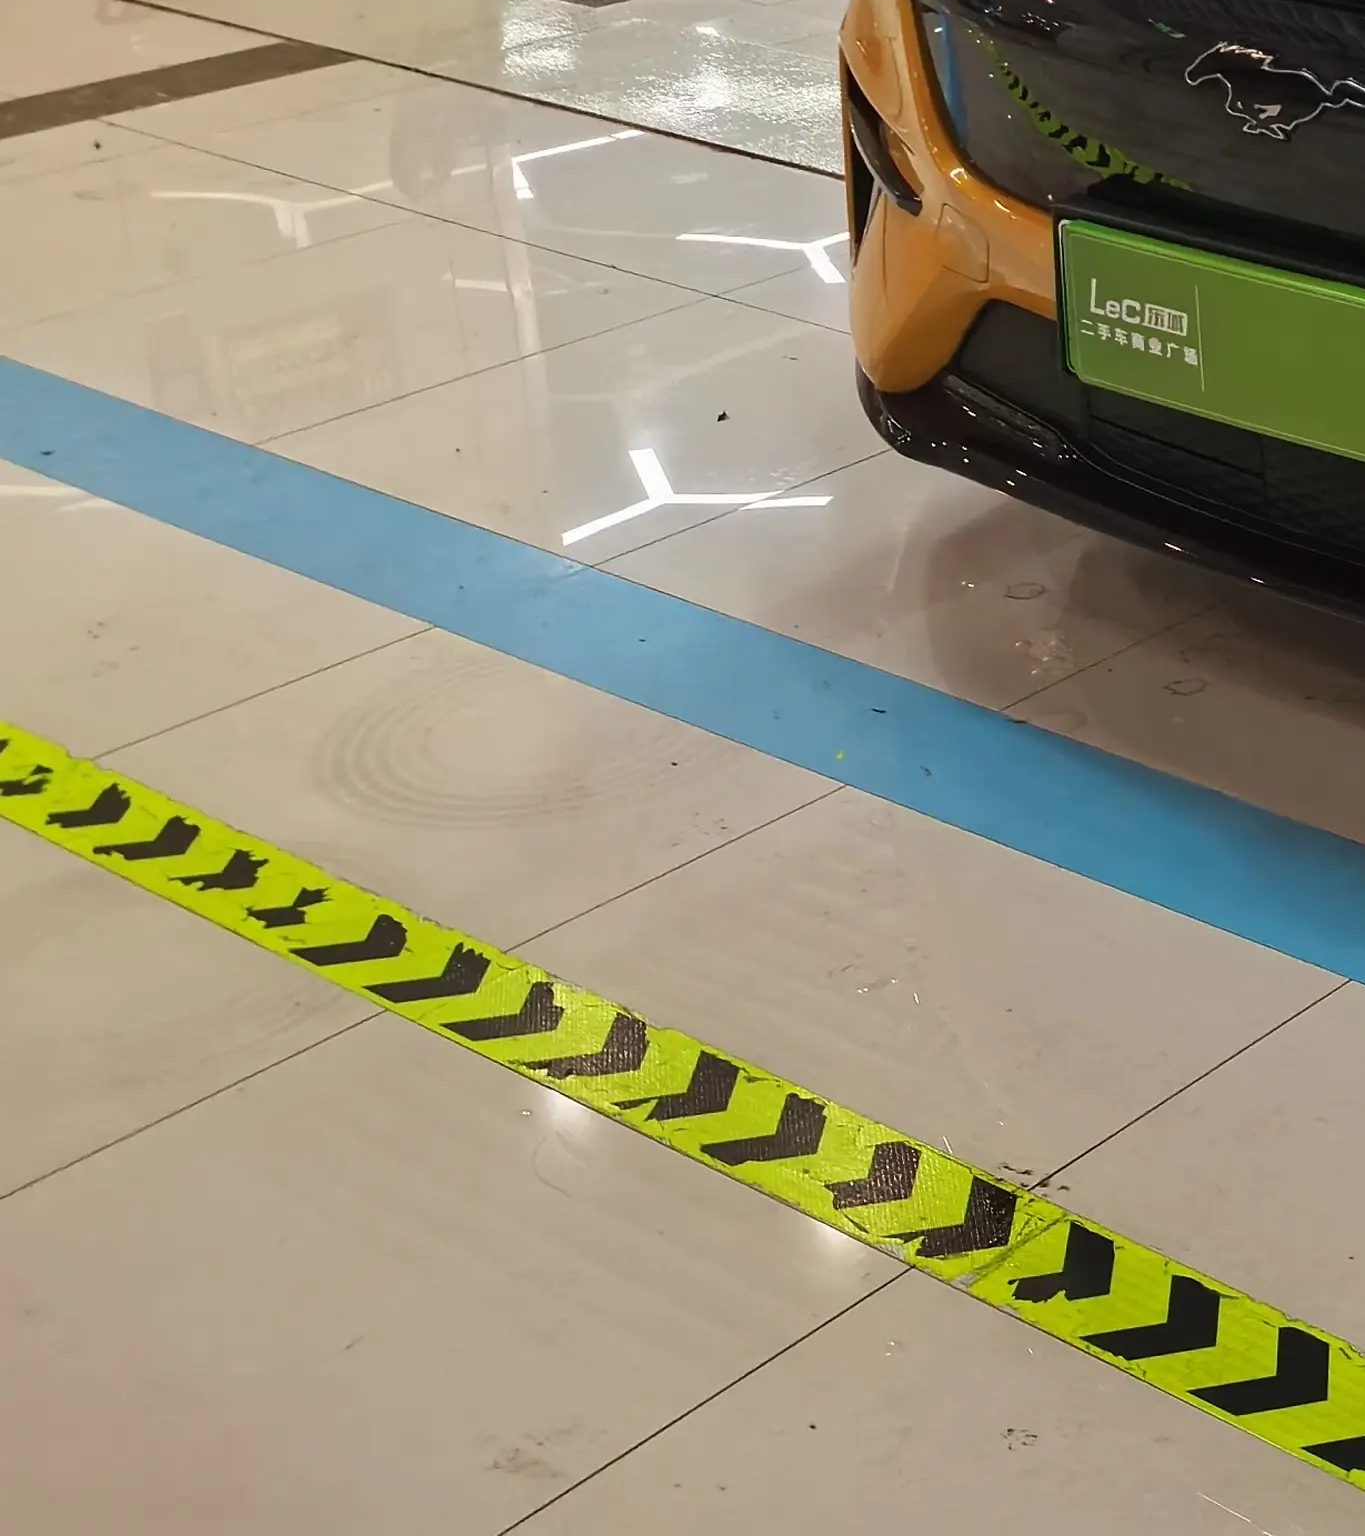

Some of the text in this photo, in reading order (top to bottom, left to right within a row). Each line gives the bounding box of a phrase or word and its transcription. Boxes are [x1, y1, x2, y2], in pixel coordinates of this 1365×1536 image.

[1089, 277, 1141, 325] LeC
[1080, 317, 1199, 366] 二手车商业广场
